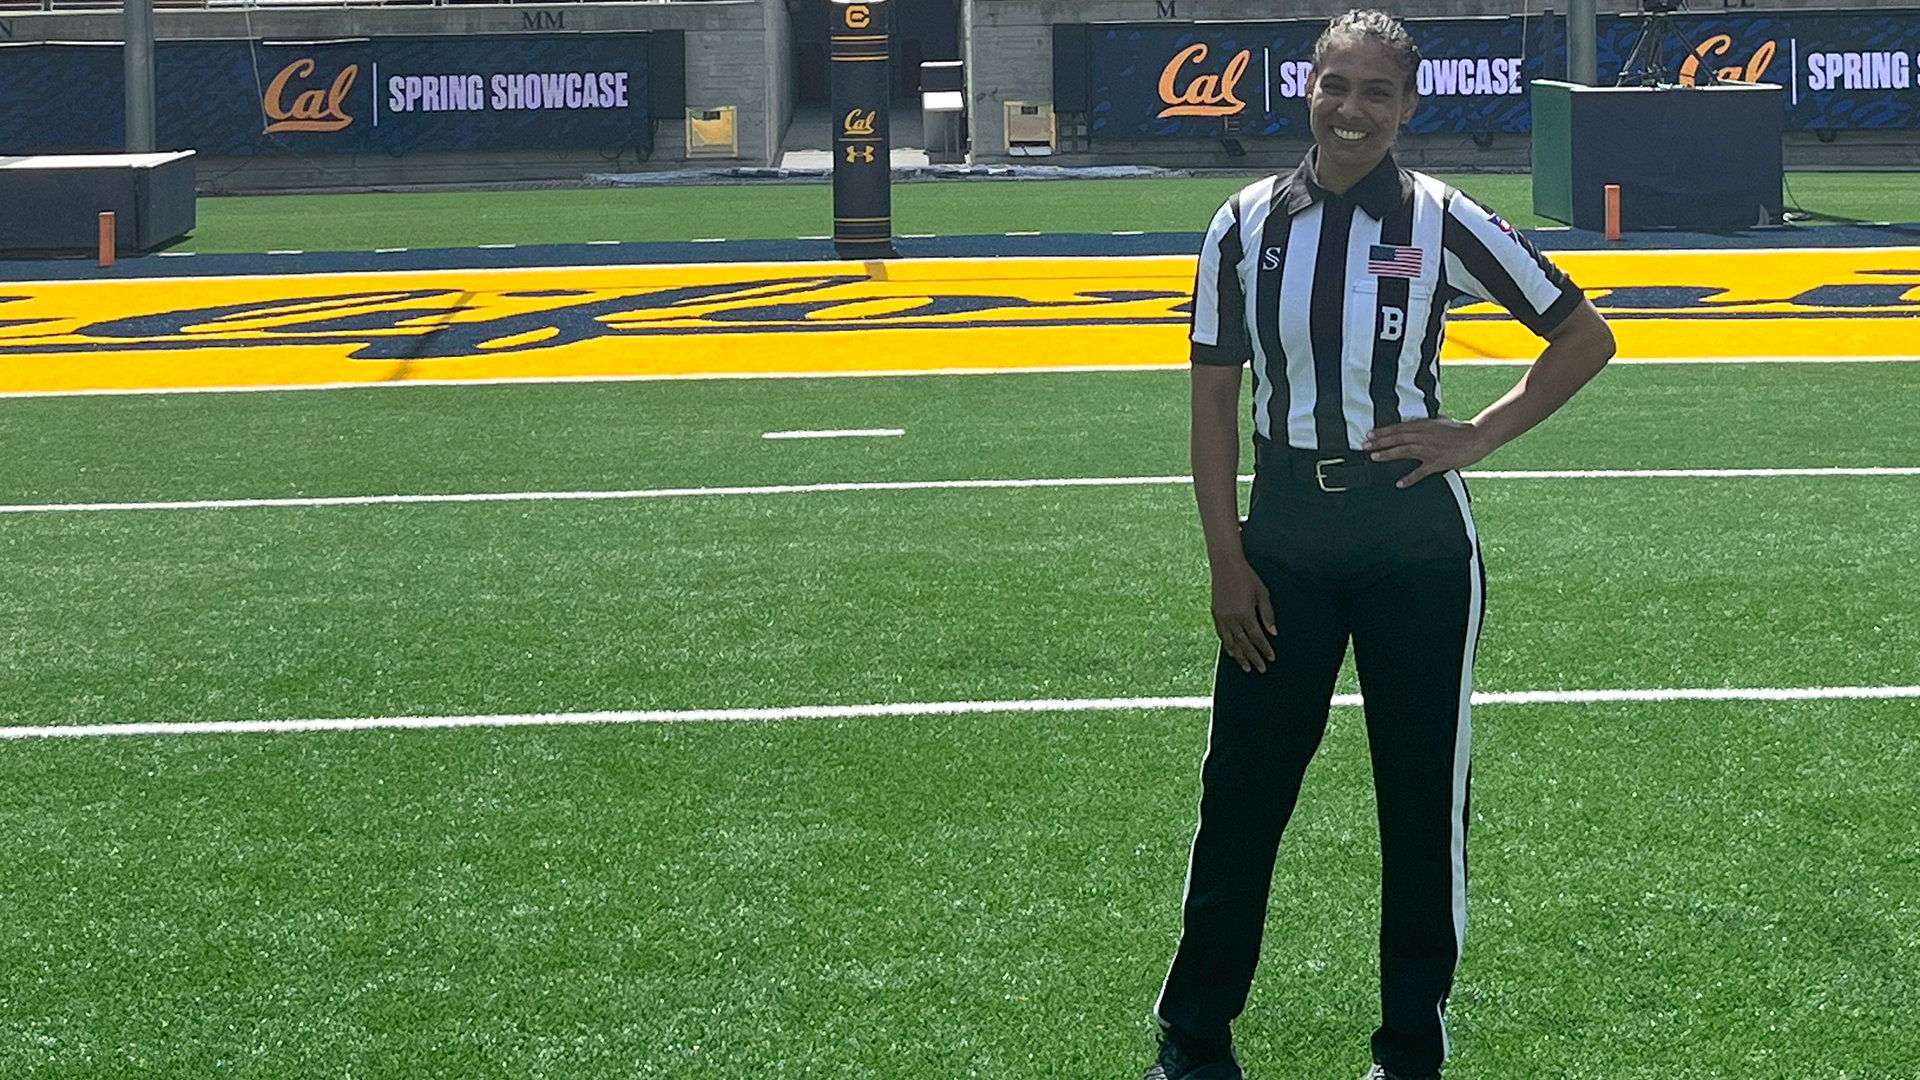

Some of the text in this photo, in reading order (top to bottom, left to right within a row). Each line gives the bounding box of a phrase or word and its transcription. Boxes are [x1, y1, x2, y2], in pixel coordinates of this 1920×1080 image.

[522, 10, 565, 30] MM
[1155, 0, 1177, 19] M
[1157, 43, 1250, 119] Cal
[1417, 58, 1523, 96] OWCASE
[1808, 51, 1910, 91] SPRING
[263, 58, 629, 135] Cal SPRING SHOWCASE
[844, 108, 876, 135] Cal
[1262, 246, 1281, 271] S
[1380, 306, 1405, 341] B
